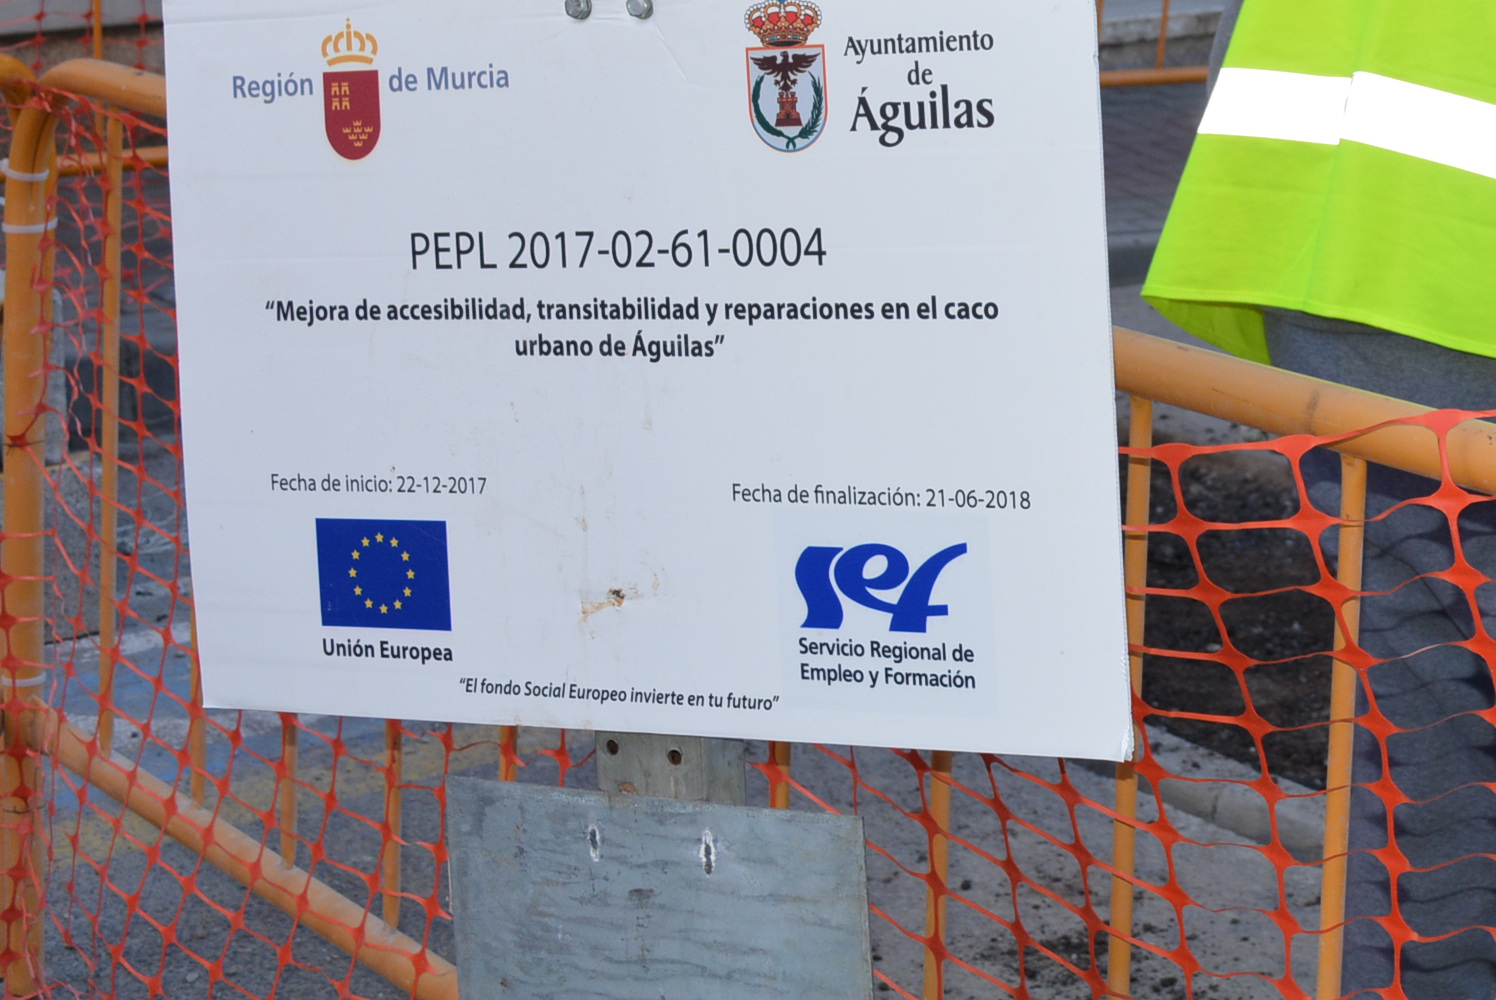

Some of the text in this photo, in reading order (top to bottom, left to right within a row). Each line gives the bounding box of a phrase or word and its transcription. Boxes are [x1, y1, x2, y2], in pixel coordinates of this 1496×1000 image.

[844, 30, 993, 63] Ayuntamiento
[233, 64, 509, 104] Región de Murcia
[908, 61, 932, 85] de
[850, 84, 994, 147] Águilas
[411, 228, 826, 269] PEPL 2017-02-61-0004
[266, 296, 998, 326] “Mejora de accesibilidad, transitabilidad y reparaciones en el caco
[515, 330, 724, 363] urbano de Águilas”
[271, 473, 486, 494] Fecha de inicio: 22-12-2017
[733, 484, 1030, 509] Fecha de finalización: 21-06-2018
[795, 543, 967, 633] sef
[323, 639, 452, 664] Unión Europea
[799, 637, 974, 663] Servicio Regional de
[801, 663, 975, 688] Empleo y Formación
[460, 678, 779, 710] “El fondo Social Europeo invierte en tu futuro”
